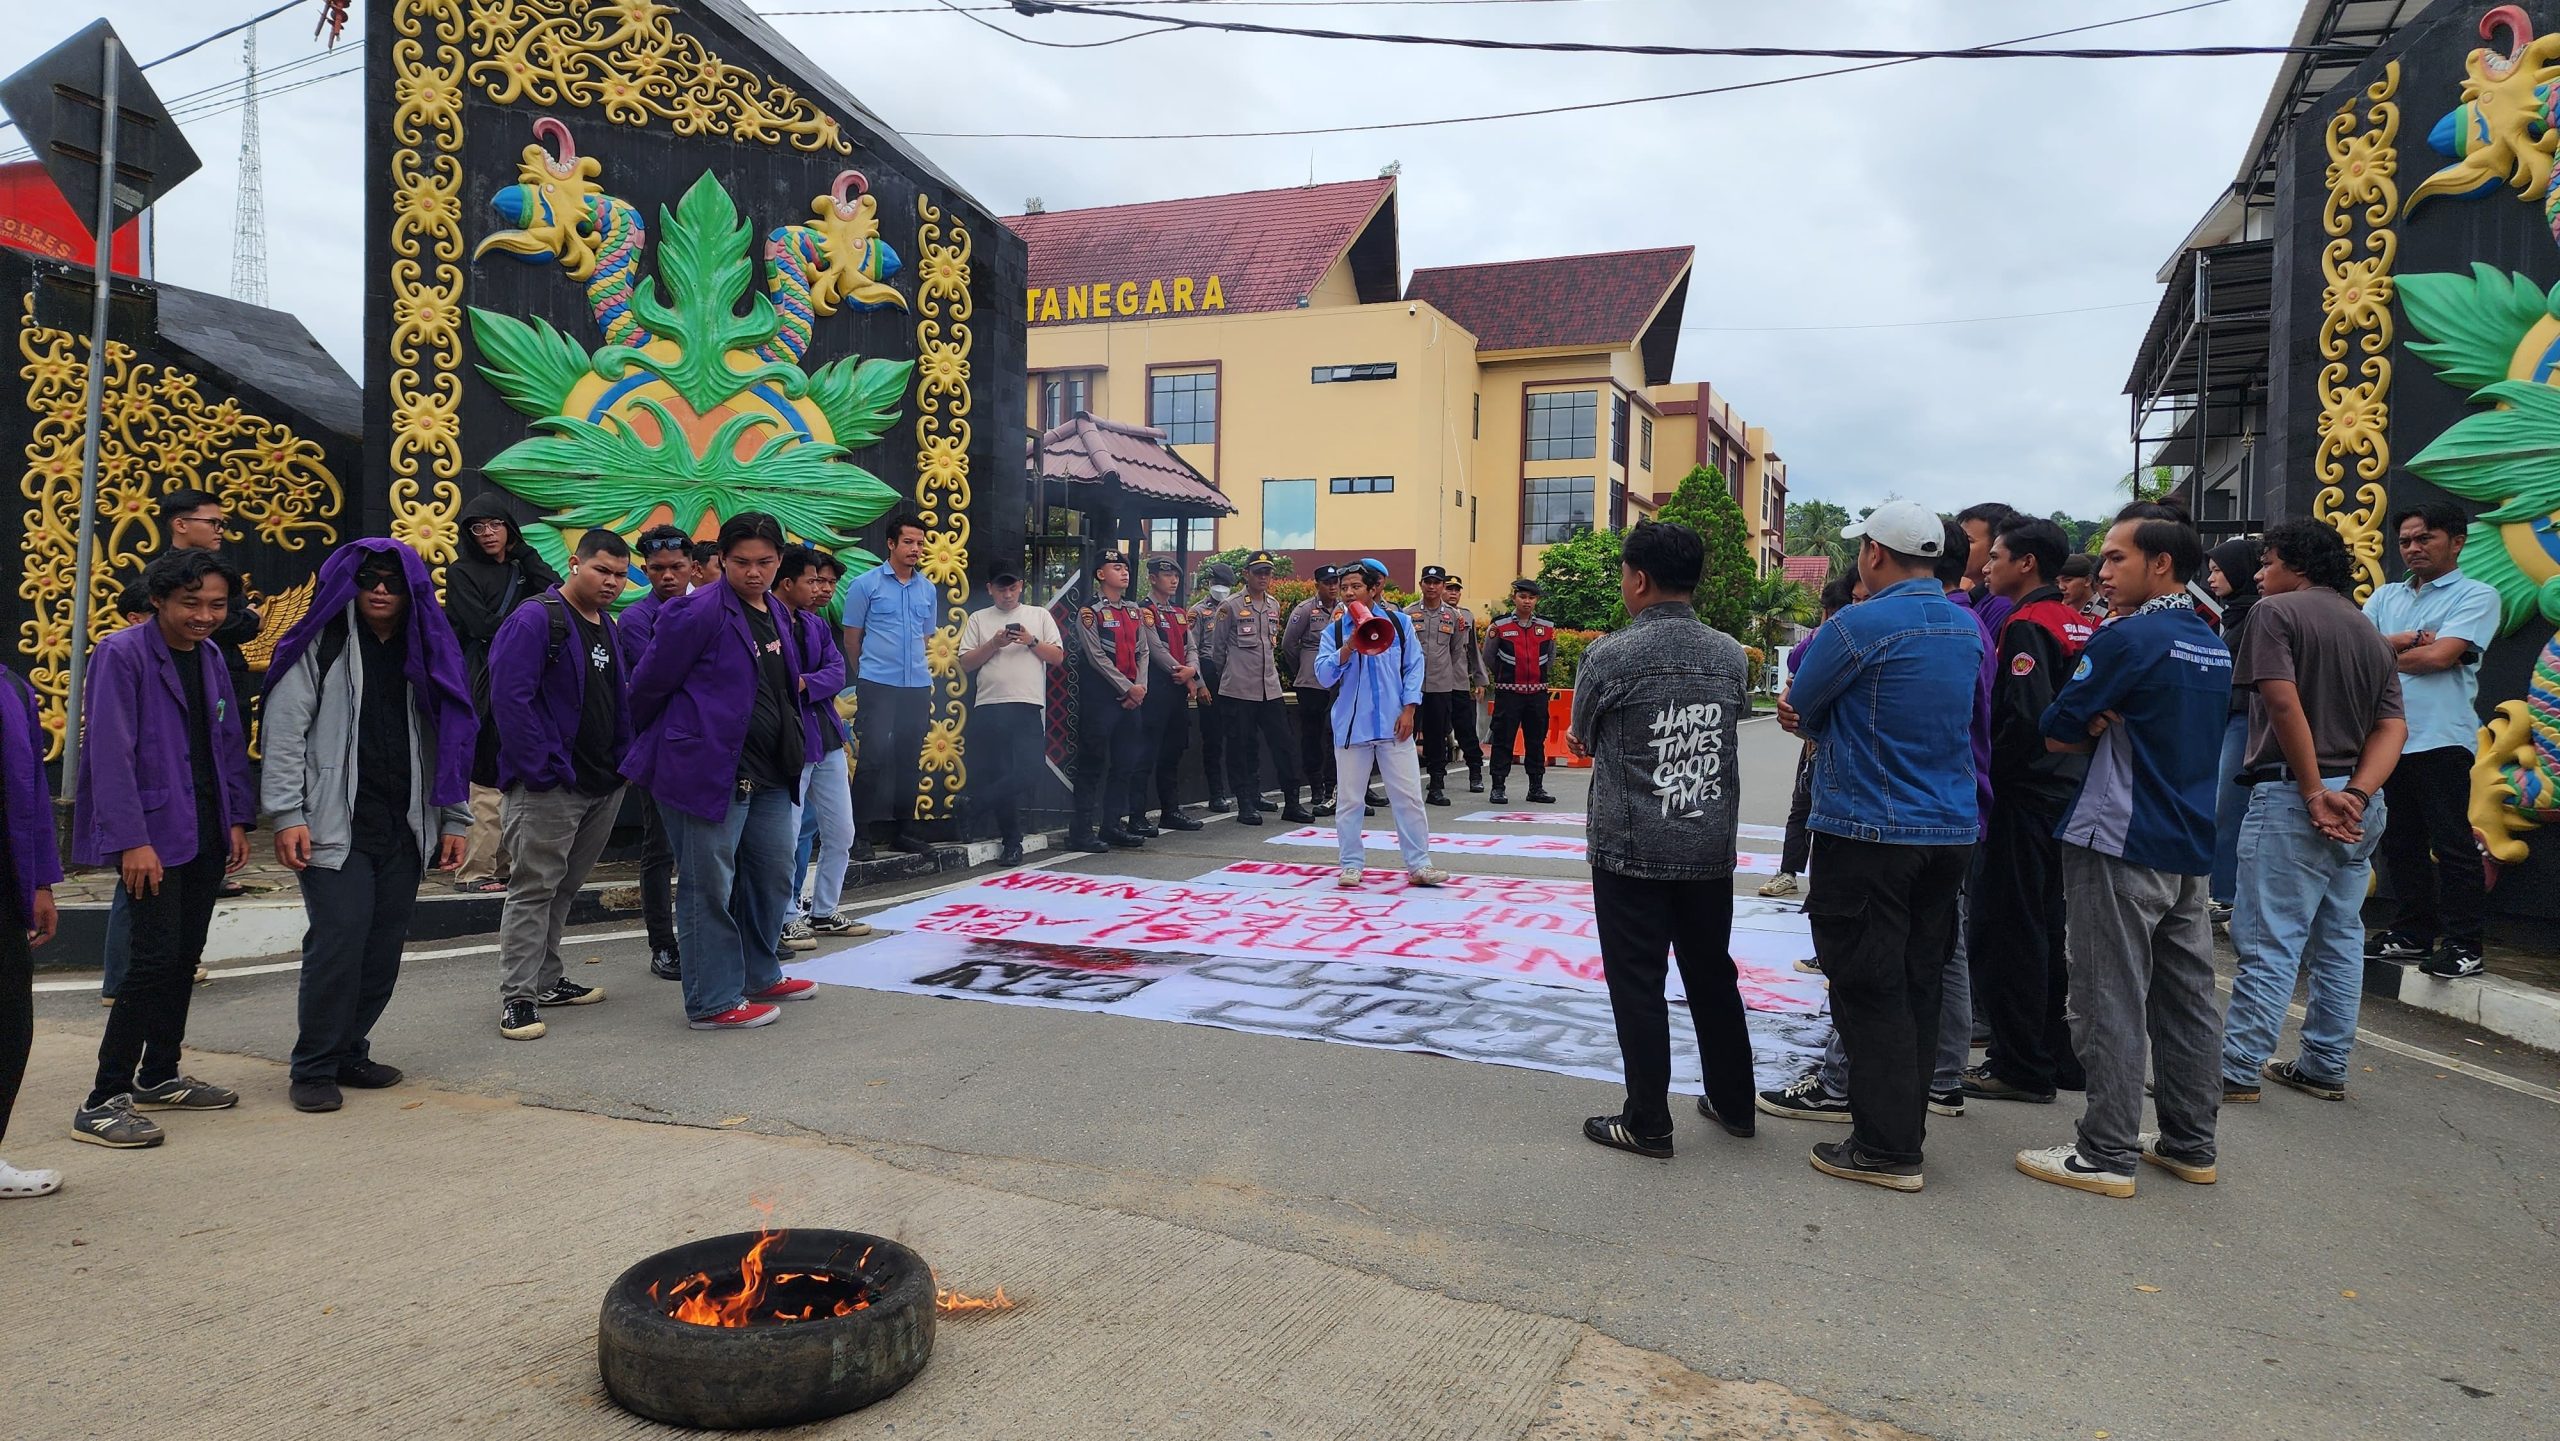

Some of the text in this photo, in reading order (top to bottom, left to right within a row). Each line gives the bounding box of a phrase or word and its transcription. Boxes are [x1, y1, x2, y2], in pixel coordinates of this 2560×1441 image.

[0, 218, 71, 257] OLRES
[1648, 698, 1722, 737] HARD
[1648, 727, 1722, 764] TIMES
[1652, 753, 1720, 787] GOOD
[1652, 777, 1722, 819] TIMES
[1119, 906, 1484, 940] BOBROK
[1078, 921, 1604, 981] NSTITUSI
